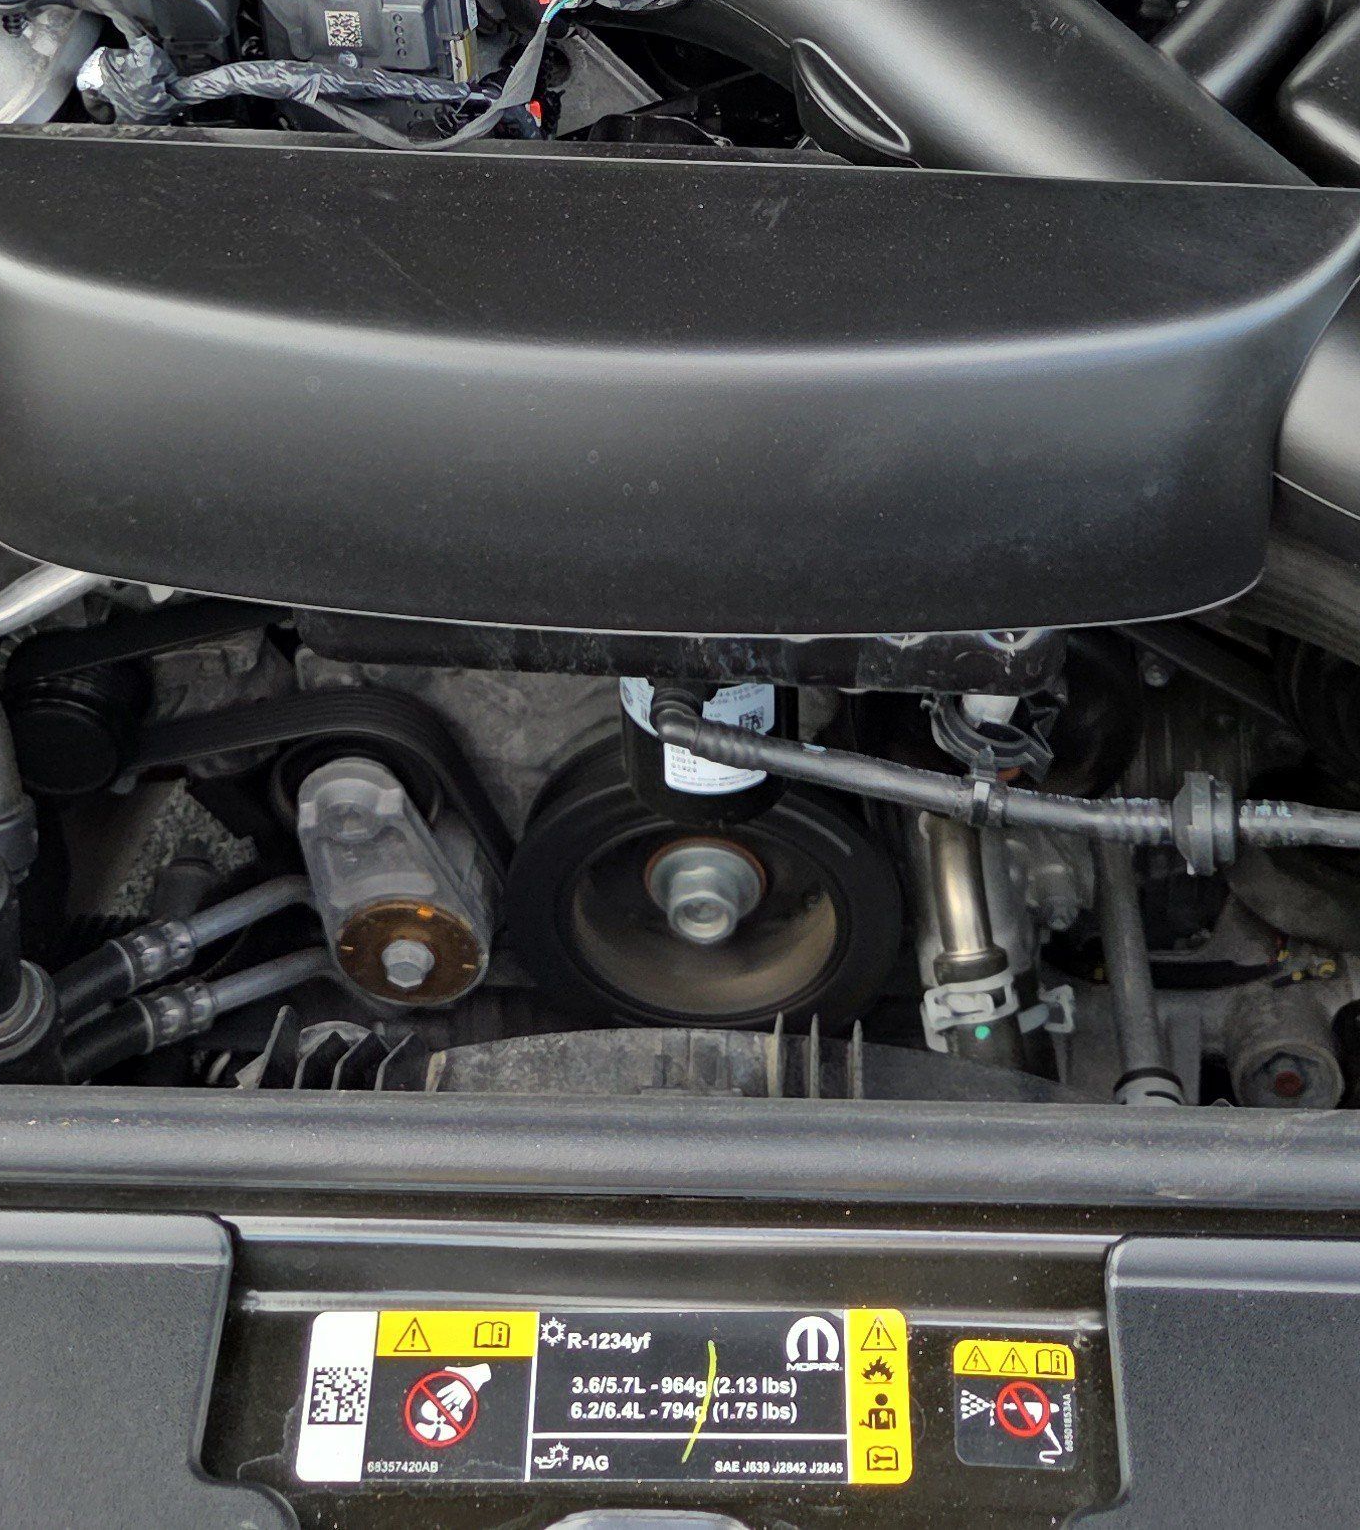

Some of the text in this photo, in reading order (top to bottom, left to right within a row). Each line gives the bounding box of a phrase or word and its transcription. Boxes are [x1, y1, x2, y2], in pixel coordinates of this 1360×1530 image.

[566, 1331, 652, 1353] R-1234yf
[786, 1362, 841, 1372] MOPAR
[571, 1376, 647, 1395] 3.6/5.7L
[661, 1376, 708, 1398] 964g
[712, 1376, 758, 1398] (2.13
[761, 1376, 798, 1398] lbs)
[570, 1401, 646, 1420] 6.2/6.4L
[712, 1401, 758, 1423] (1.75
[761, 1401, 798, 1423] lbs)
[366, 1460, 439, 1474] 68357420AB
[572, 1454, 610, 1471] PAG
[714, 1460, 740, 1473] SAE
[742, 1460, 770, 1473] J639
[772, 1461, 807, 1474] J2842
